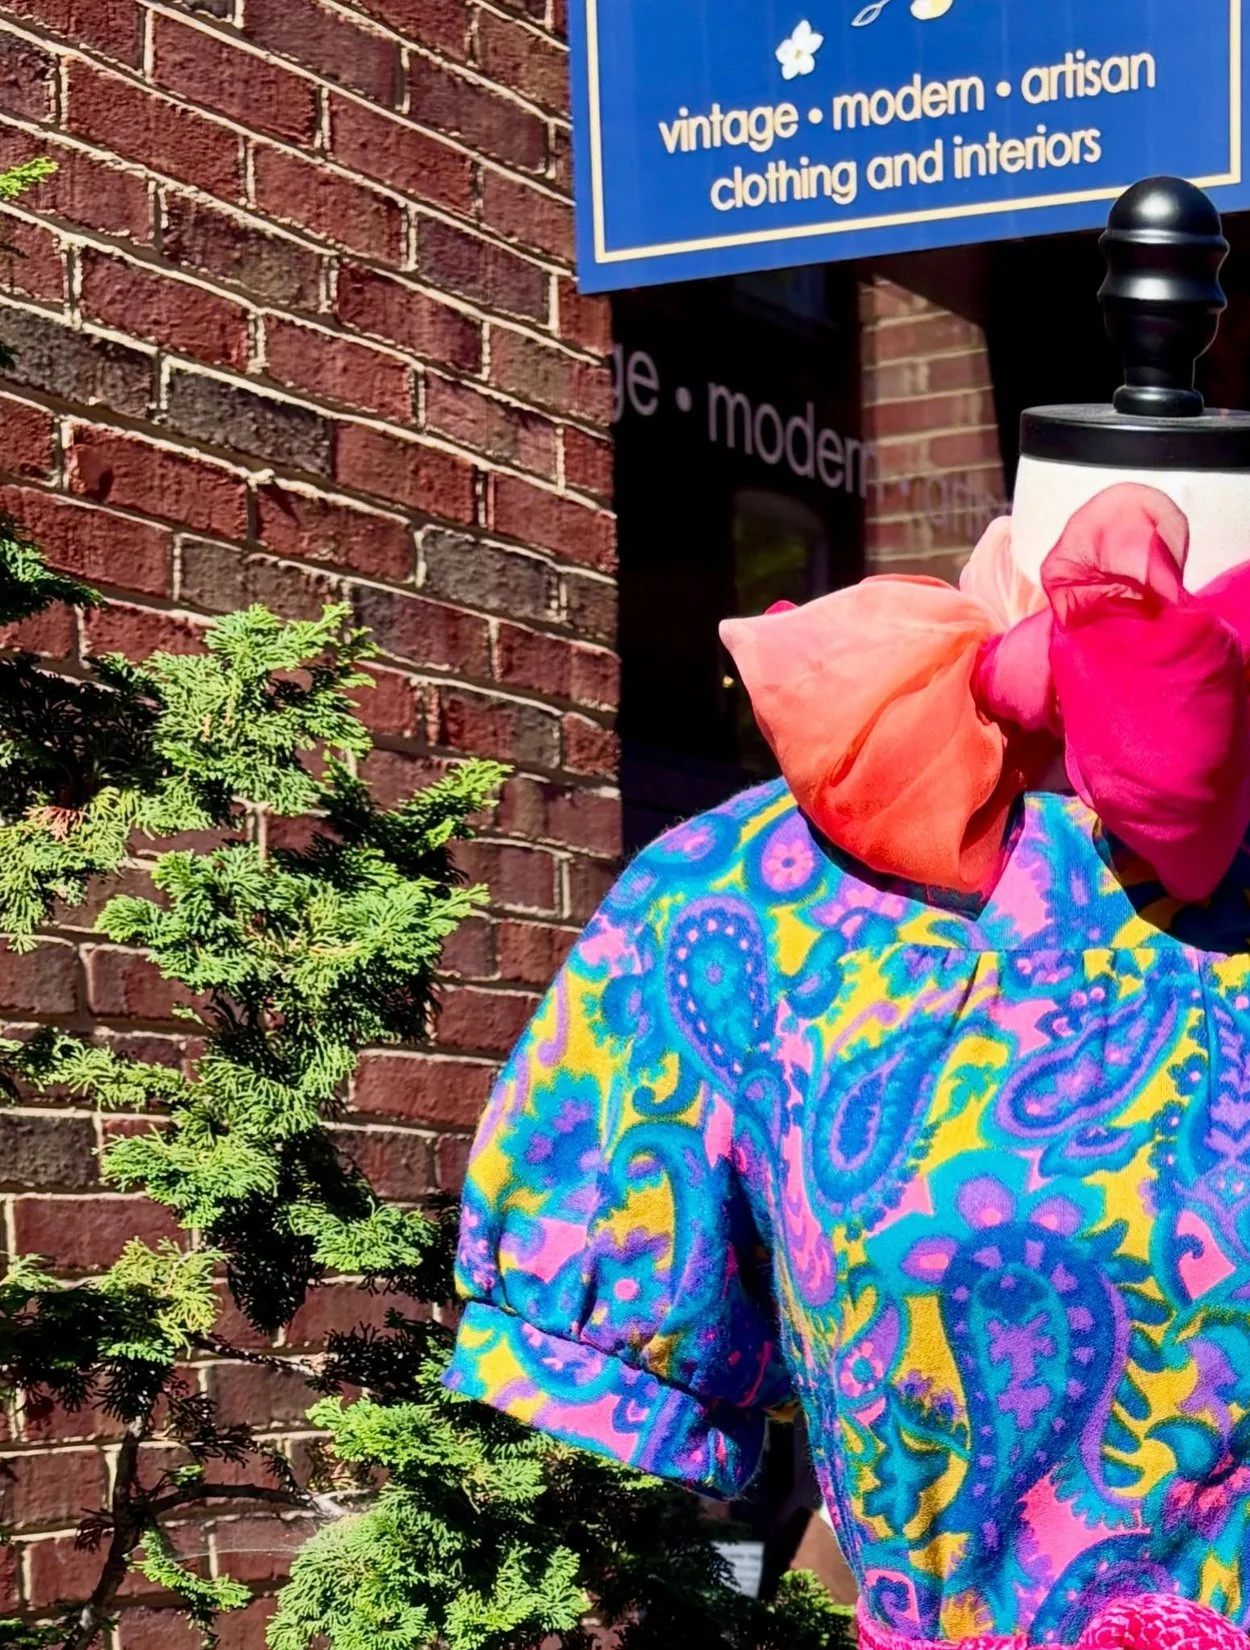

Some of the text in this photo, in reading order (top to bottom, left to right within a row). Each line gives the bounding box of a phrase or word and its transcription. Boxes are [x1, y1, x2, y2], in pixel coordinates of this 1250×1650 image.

[658, 49, 1156, 154] vintage modern artisan
[710, 124, 1101, 212] clothing and interiors
[707, 381, 884, 504] modern
